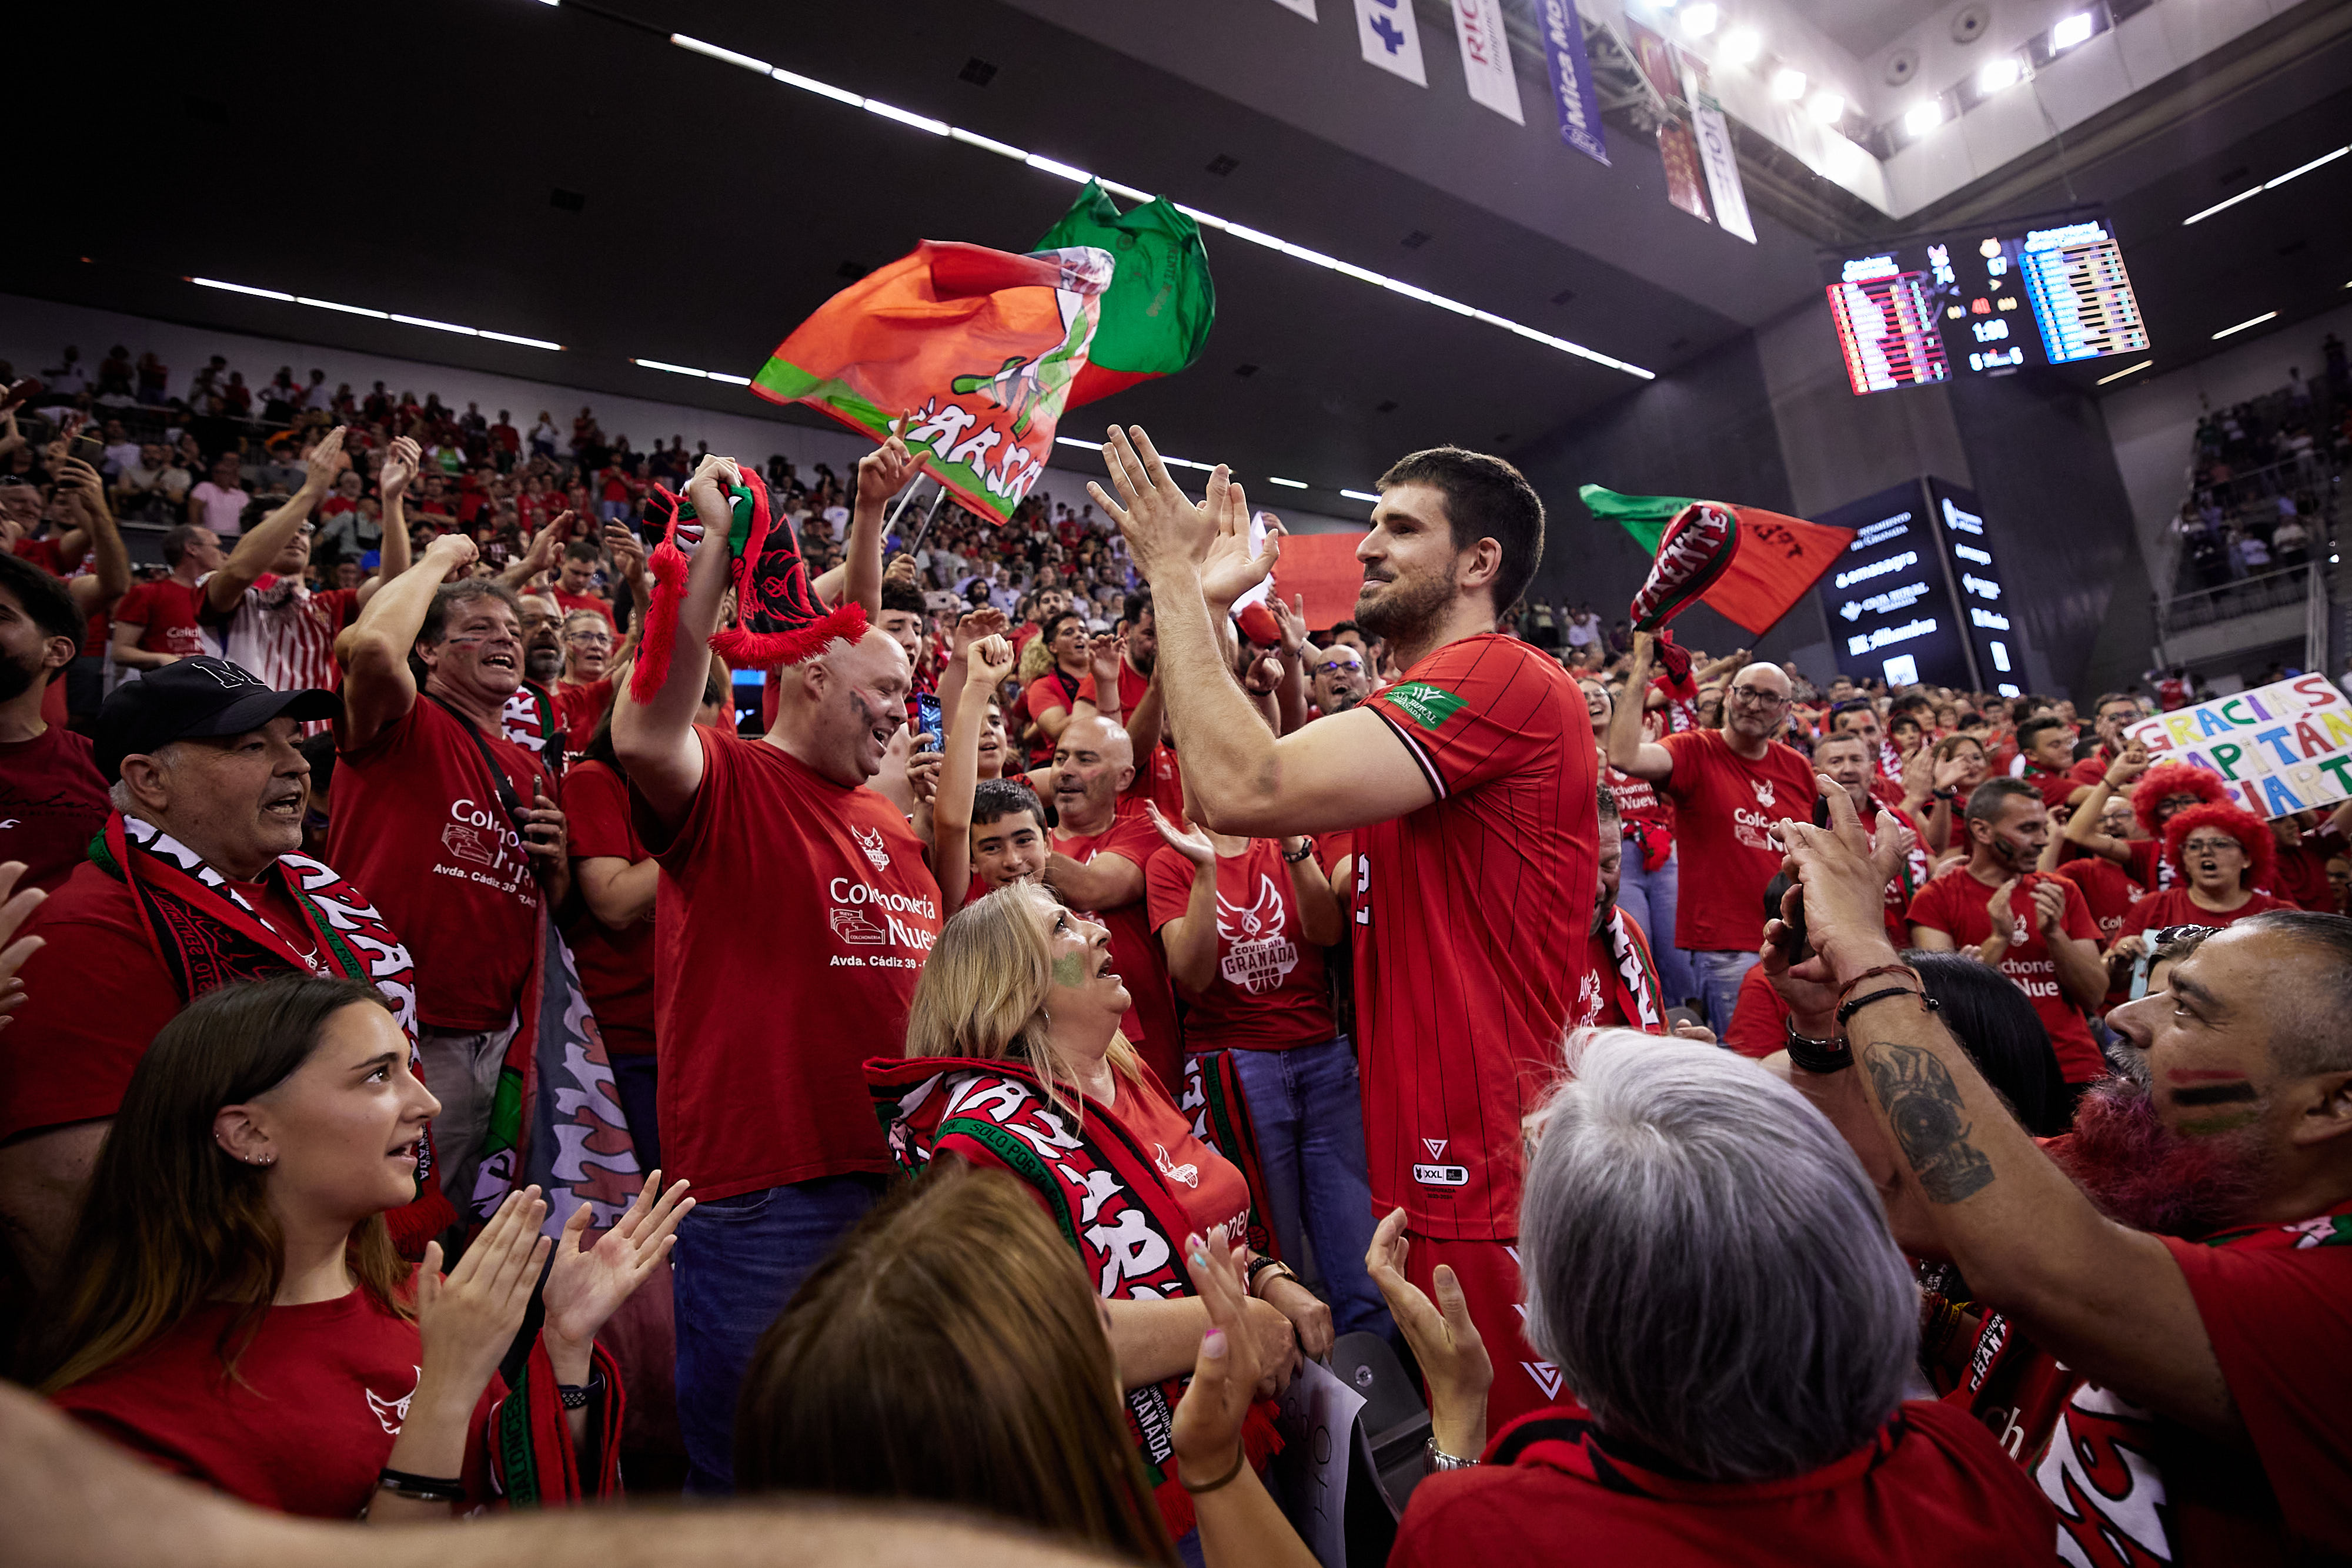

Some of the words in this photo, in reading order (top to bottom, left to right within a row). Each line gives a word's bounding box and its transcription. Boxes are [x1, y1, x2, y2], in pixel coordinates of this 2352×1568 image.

[2134, 677, 2337, 754] GRACIAS
[2163, 707, 2352, 781] APITÁN
[433, 863, 467, 878] Avda.
[470, 871, 501, 888] Cádiz
[502, 882, 517, 894] 39
[884, 914, 937, 951] Nue
[1235, 938, 1281, 955] COVIRAN
[830, 955, 866, 967] Avda.
[869, 955, 903, 968] Cádiz
[904, 958, 916, 969] 39
[1225, 945, 1295, 975] GRANADA
[970, 1122, 1009, 1148] SOLO
[1006, 1145, 1036, 1174] POR
[1425, 1170, 1443, 1178] XXL
[1129, 1388, 1172, 1465] RANADA
